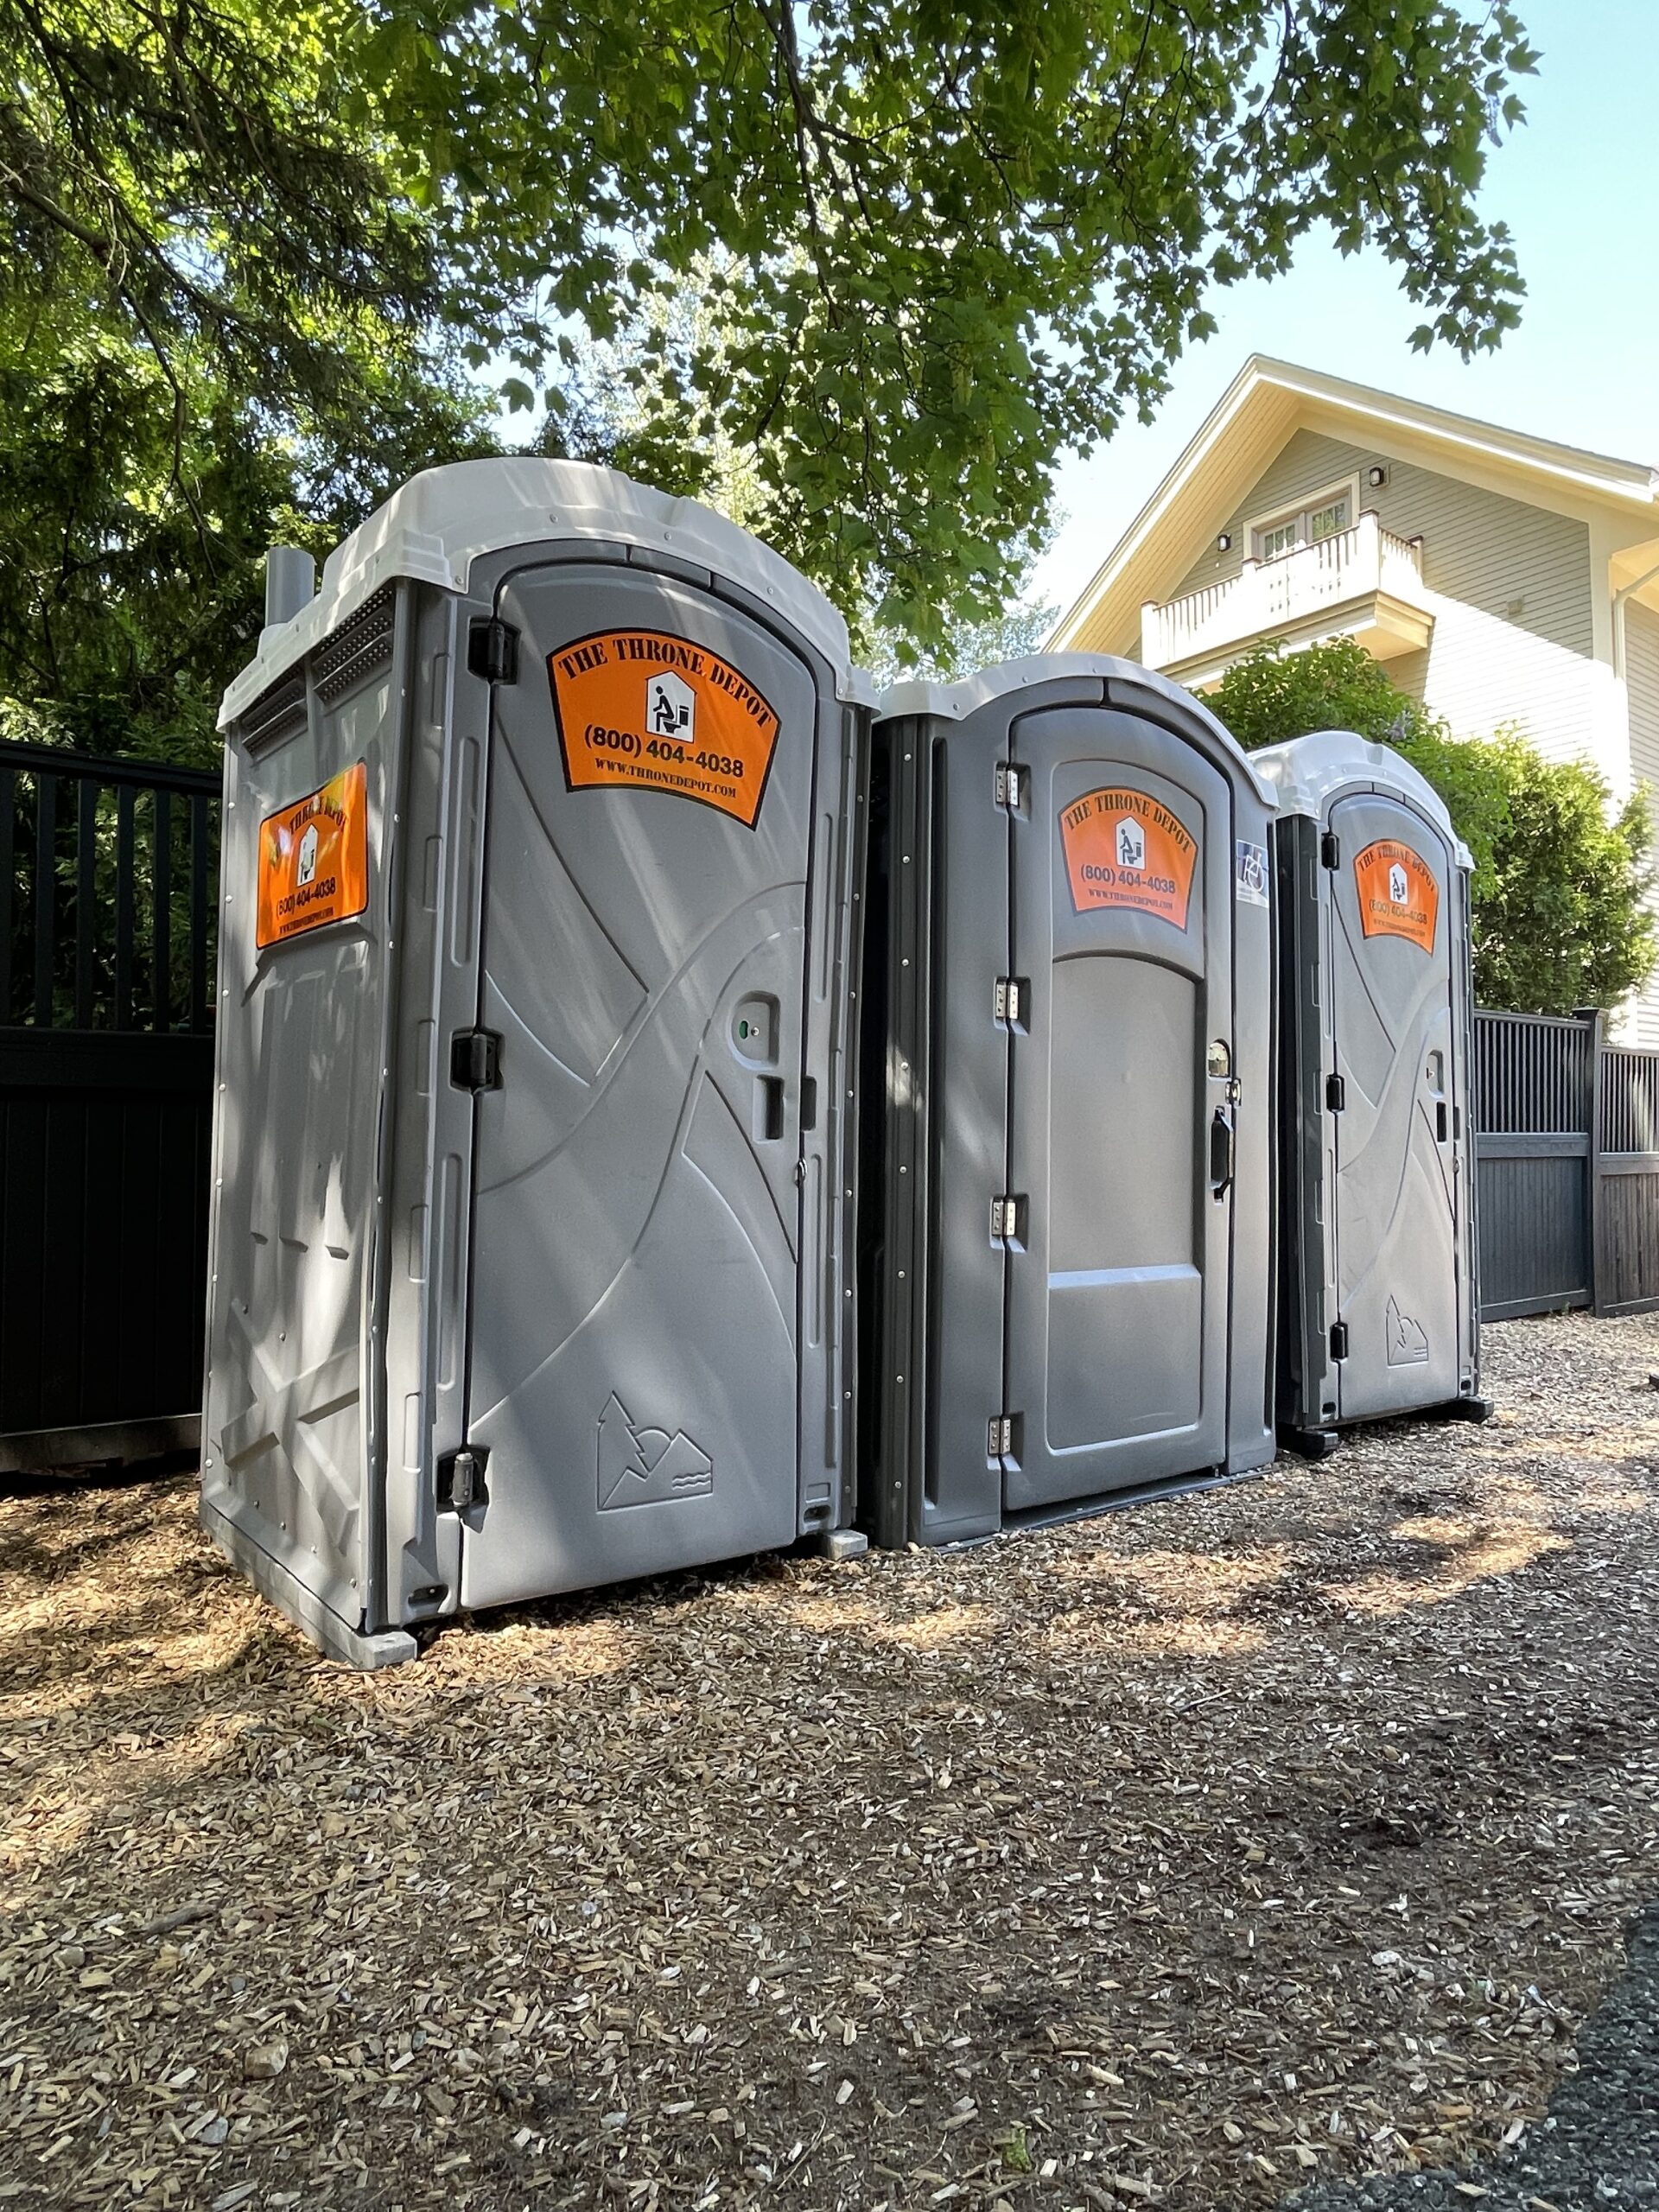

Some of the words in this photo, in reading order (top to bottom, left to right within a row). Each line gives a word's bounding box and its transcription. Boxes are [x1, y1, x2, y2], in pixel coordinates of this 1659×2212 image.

[558, 642, 608, 680] THE
[613, 638, 705, 676] THRONE
[709, 664, 772, 728] DEPOT
[584, 724, 642, 759] (800)
[646, 739, 744, 779] 404-4038
[594, 757, 736, 798] WWW.THRONEDEPOT.COM
[1065, 800, 1091, 830] THE
[1095, 793, 1150, 817] THRONE
[1153, 807, 1192, 854] DEPOT
[1081, 863, 1116, 886] (800)
[1118, 870, 1175, 893] 404-4038
[1357, 849, 1376, 872] THE
